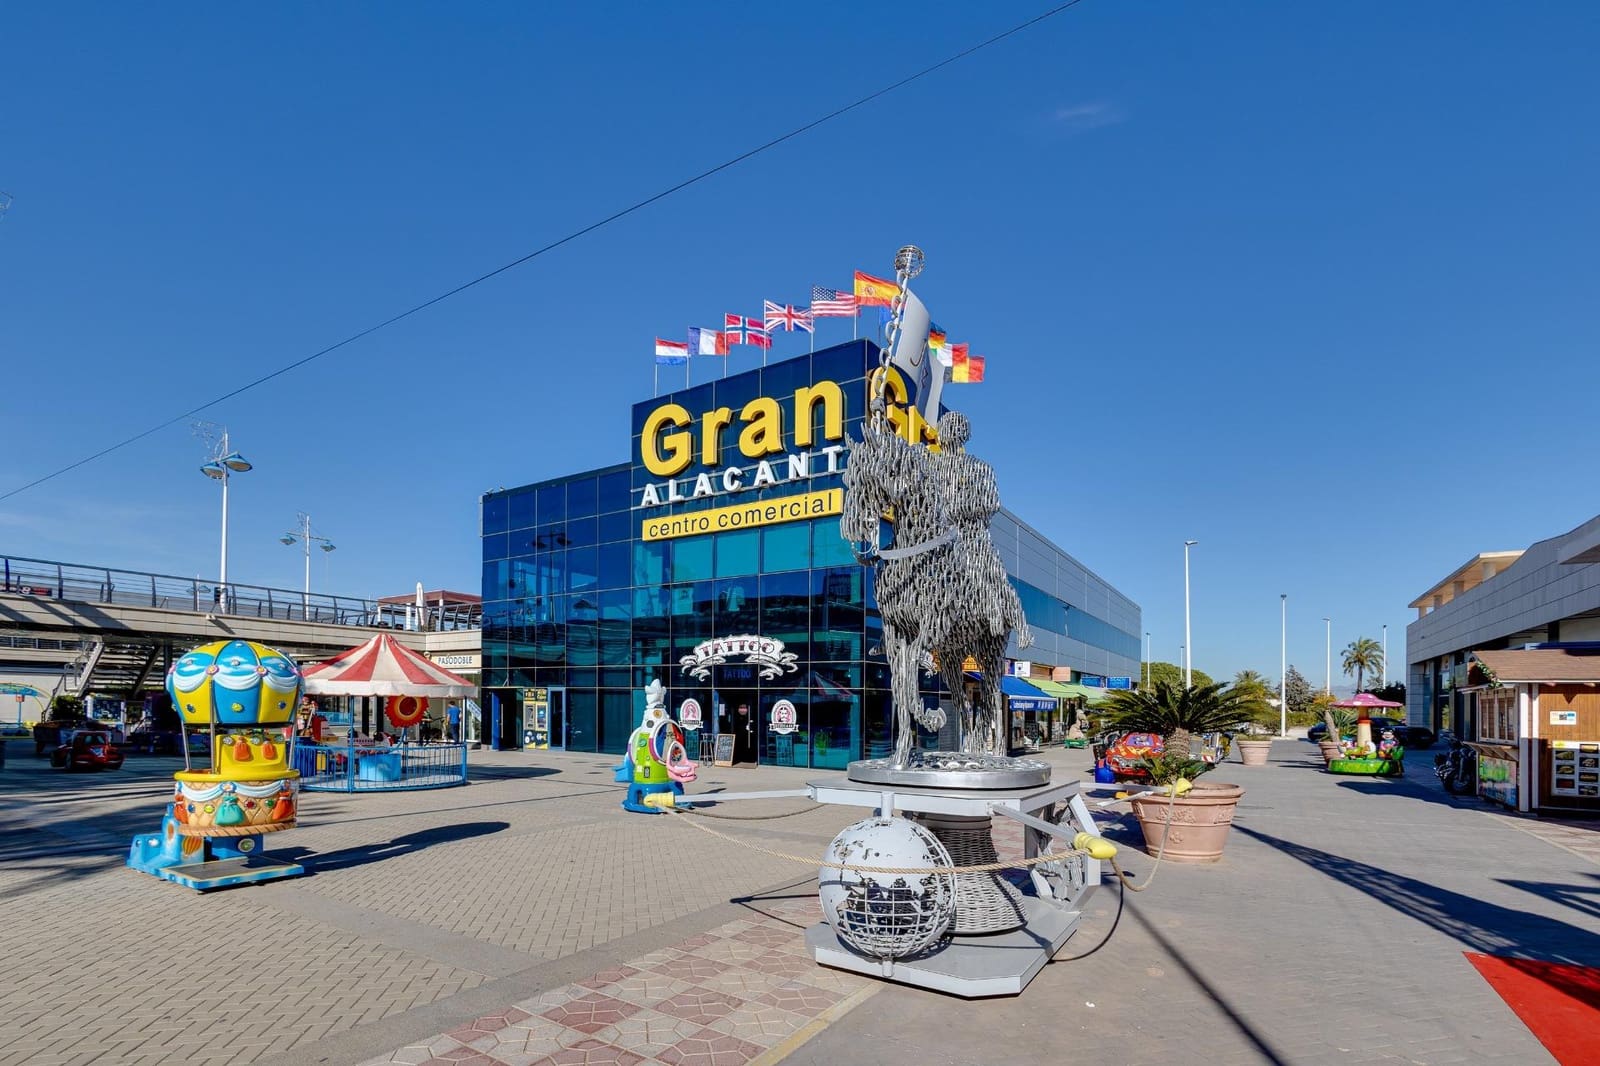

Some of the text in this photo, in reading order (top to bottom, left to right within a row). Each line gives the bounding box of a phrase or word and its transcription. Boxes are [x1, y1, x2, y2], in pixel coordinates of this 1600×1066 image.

[641, 380, 843, 477] Gran
[641, 445, 843, 506] ALACANT
[649, 492, 833, 538] centro comercial
[438, 656, 473, 665] PASODOBLE
[701, 640, 775, 657] TATTOO
